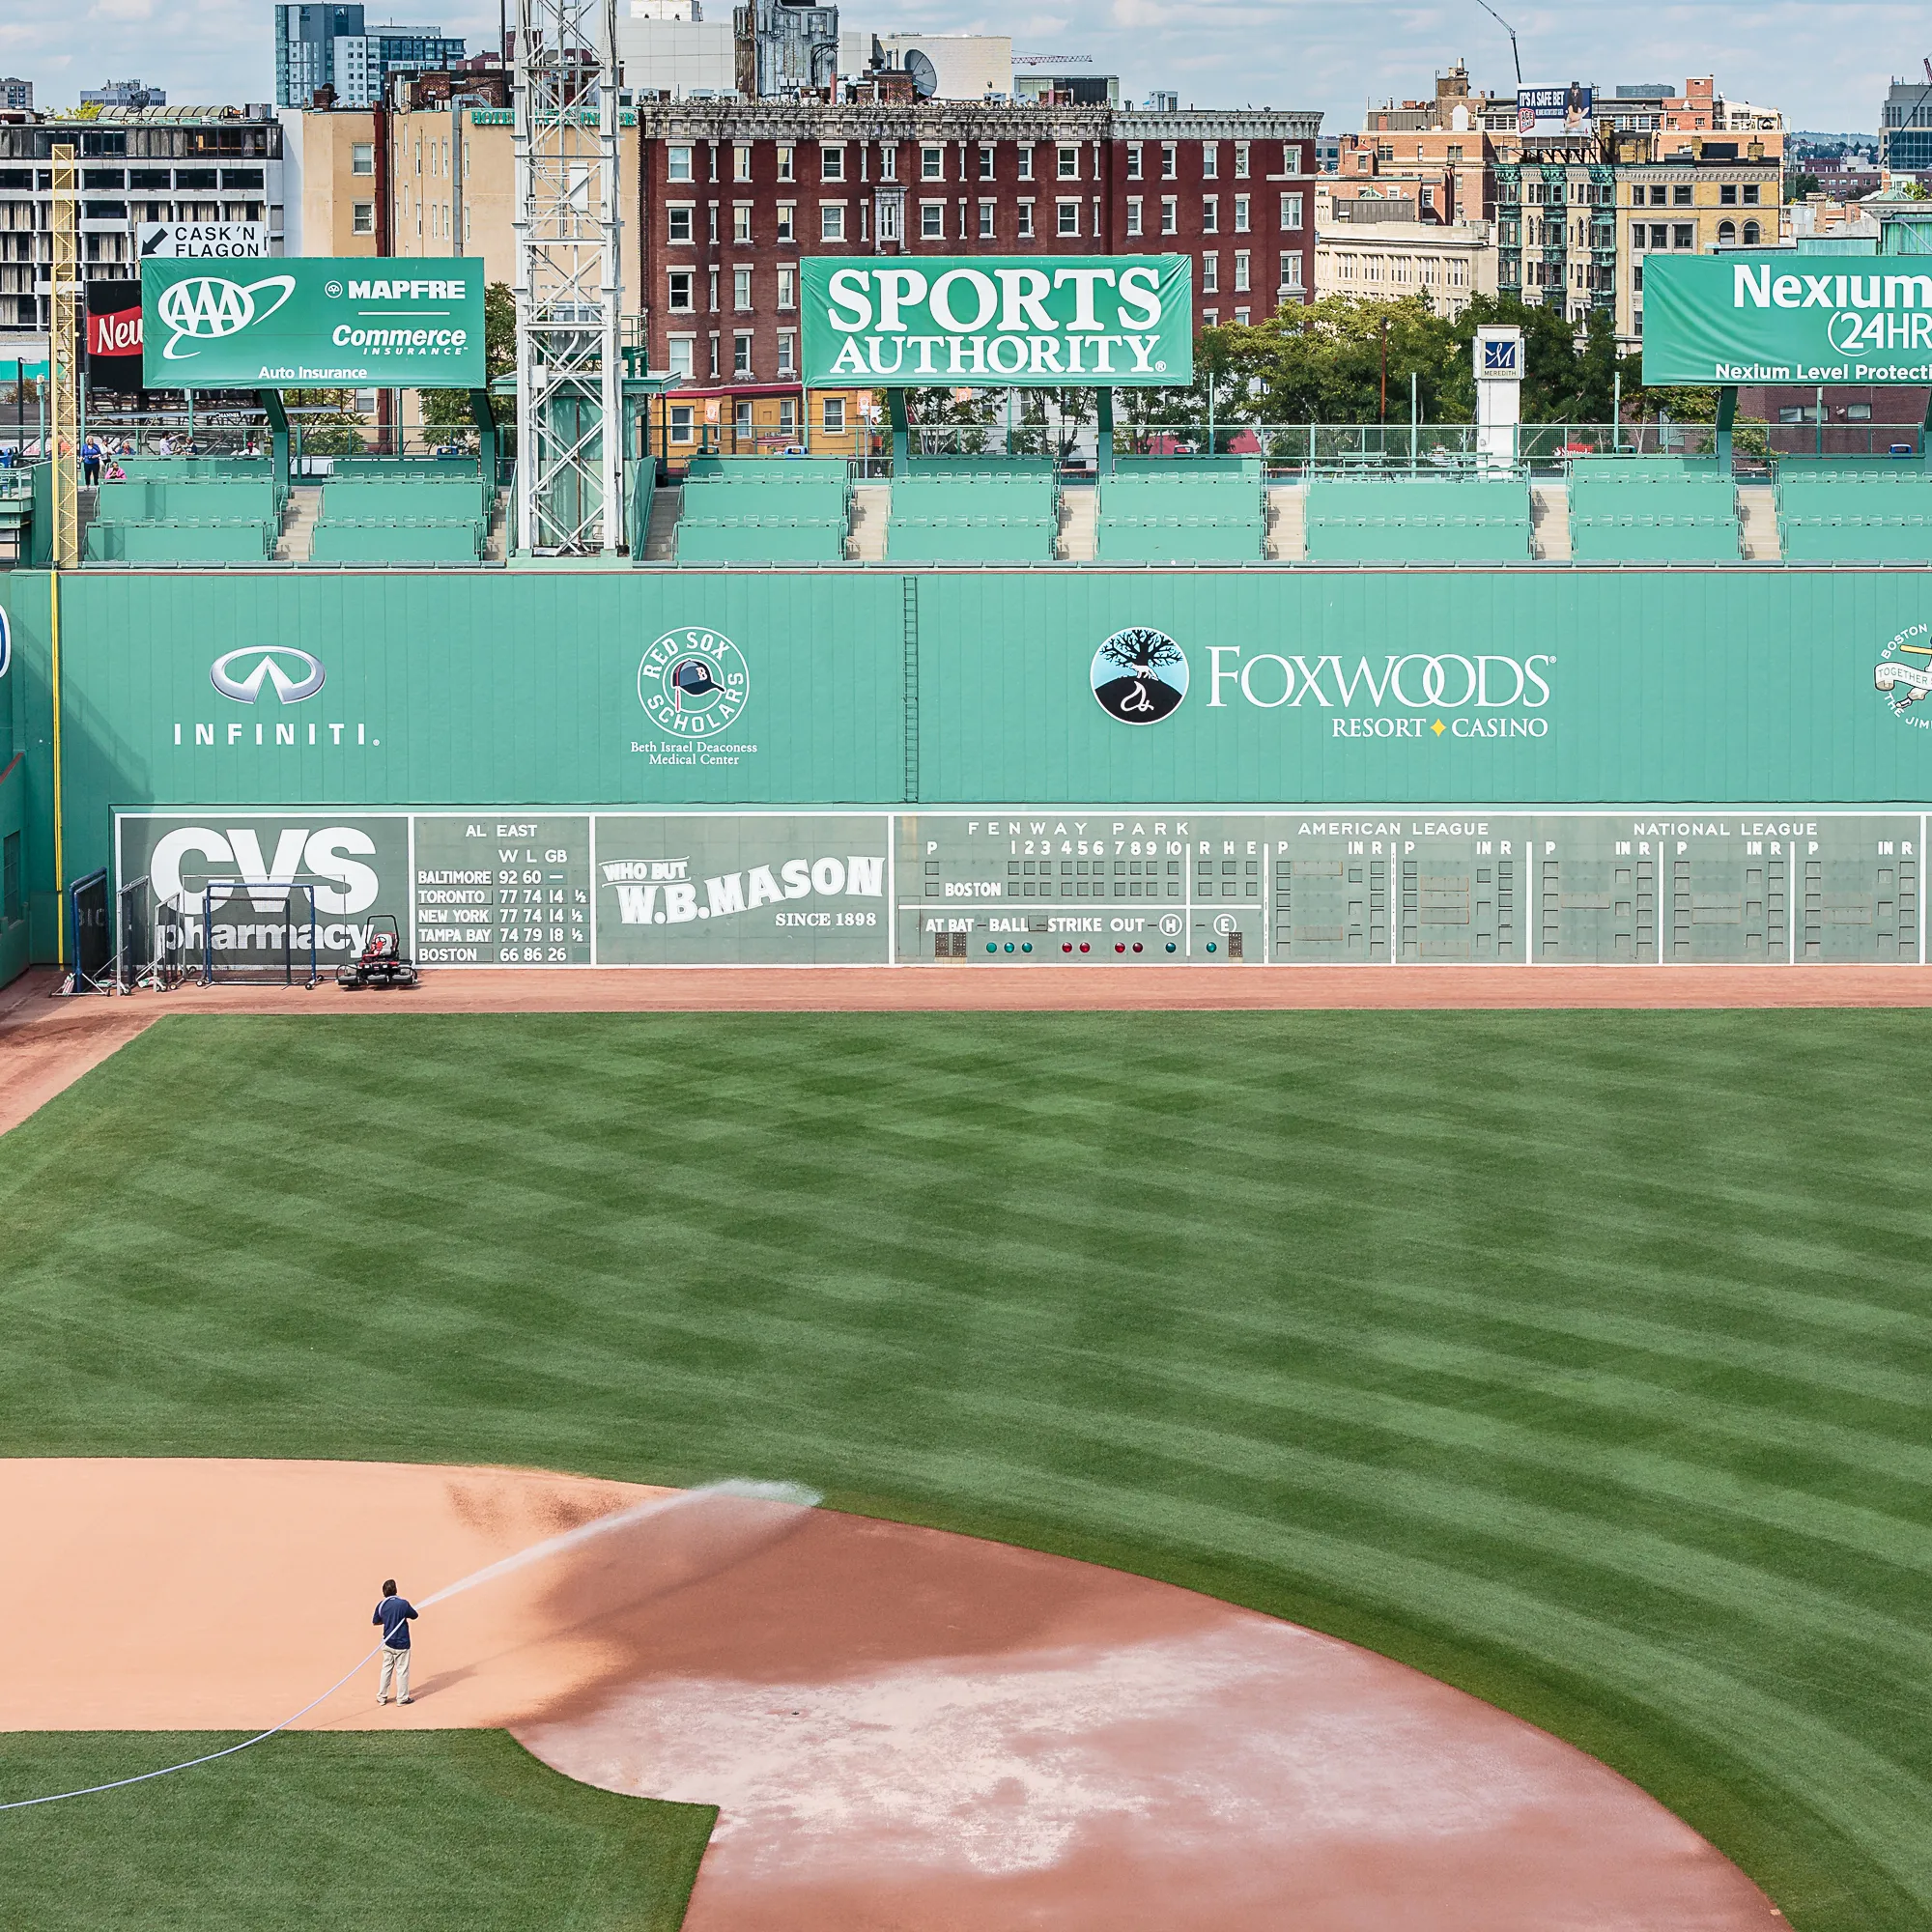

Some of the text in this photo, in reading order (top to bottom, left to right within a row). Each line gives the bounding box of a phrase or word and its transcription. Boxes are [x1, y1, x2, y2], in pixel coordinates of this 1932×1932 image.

[1537, 91, 1551, 106] SAFE
[1552, 91, 1564, 106] BET
[470, 111, 515, 125] HOTE
[175, 226, 232, 242] CASK
[175, 243, 259, 258] FLAGON
[348, 280, 466, 299] MAPFRE
[1733, 264, 1932, 309] Nexium
[169, 280, 245, 334] AAA
[827, 267, 1162, 332] SPORTS
[332, 324, 467, 347] Commerce
[361, 346, 465, 356] INSURANCE
[830, 334, 1160, 375] AUTHORITY
[257, 366, 368, 380] Auto Insurance
[1715, 363, 1932, 381] Nexium Level Protecti
[1881, 623, 1928, 659] BOSTON
[642, 632, 730, 679] RED SOX
[1205, 645, 1552, 708] FOXWOODS
[1878, 668, 1928, 685] TOGETHER
[647, 671, 744, 732] SCHOLARS
[1884, 692, 1932, 730] THE JIM
[174, 723, 365, 746] INFINITI
[1331, 718, 1548, 738] RESORT CASINO
[630, 740, 758, 753] Beth Israel Deaconess
[648, 753, 740, 765] Medical Center
[465, 824, 538, 838] AL EAST
[968, 821, 1189, 836] FENWAY PARK
[1297, 822, 1489, 836] AMERICAN LEAGUE
[1634, 822, 1818, 836] NATIONAL LEAGUE
[926, 839, 1257, 856] P 1 2 3 4 5 6 7 8 9 10 R H E
[1278, 840, 1382, 855] P IN R
[1405, 840, 1512, 855] P IN R
[1545, 840, 1651, 856] P IN R
[1677, 840, 1782, 856] P IN R
[1808, 840, 1914, 855] P IN R
[497, 849, 568, 864] W L GB
[150, 826, 380, 915] CVS
[417, 869, 542, 885] BALTIMORE 92 60
[602, 861, 688, 881] WHO BUT
[417, 890, 486, 904] TORONTO
[498, 889, 518, 904] 77
[523, 889, 542, 904] 74
[549, 889, 564, 904] 14
[945, 881, 1002, 897] BOSTON
[418, 909, 448, 923] NEW
[452, 909, 493, 923] YORK
[499, 908, 519, 923] 77
[523, 908, 543, 923] 74
[549, 908, 564, 923] 14
[775, 912, 877, 926] SINCE 1898
[925, 915, 1233, 935] AT BAT BALL STRIKE OUT H E
[155, 915, 375, 959] pharmacy
[417, 928, 463, 943] TAMPA
[466, 928, 492, 943] BAY
[499, 927, 519, 943] 74
[523, 927, 543, 943] 79
[549, 927, 564, 942] 18
[418, 947, 567, 962] BOSTON 66 86 26
